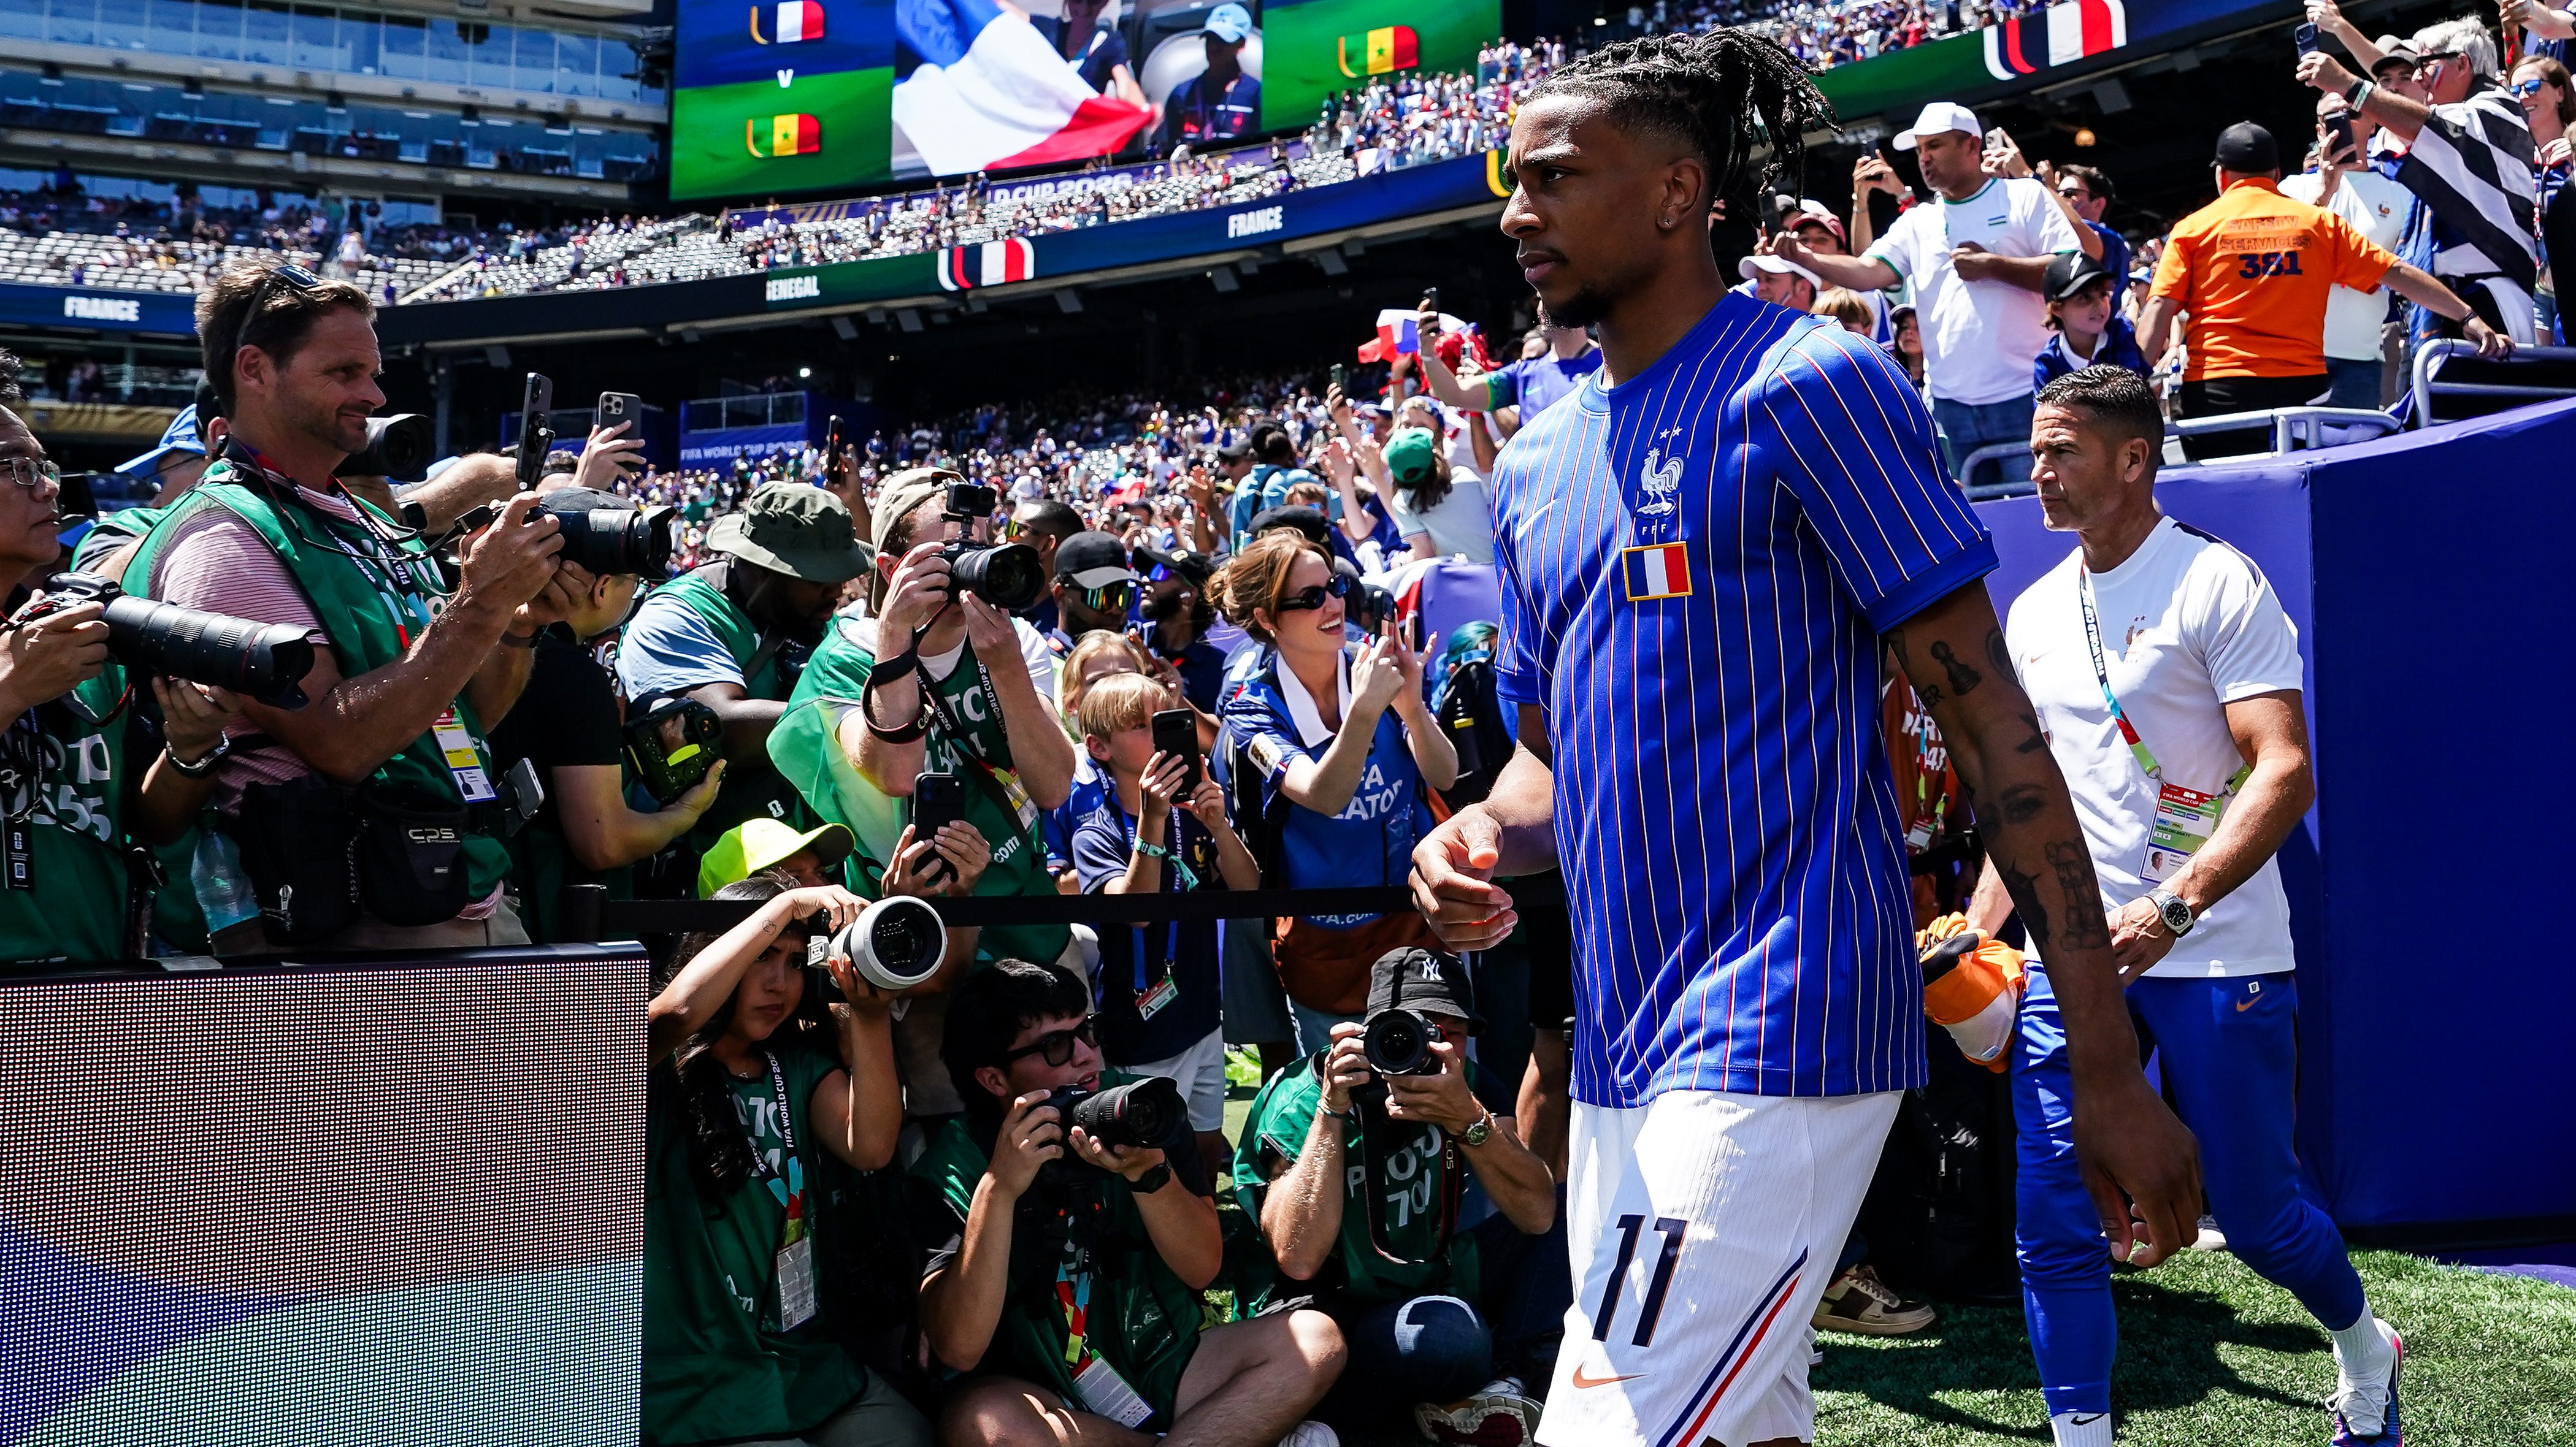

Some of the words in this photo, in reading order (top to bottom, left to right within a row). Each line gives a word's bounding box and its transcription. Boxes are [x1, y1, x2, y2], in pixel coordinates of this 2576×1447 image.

[776, 69, 794, 88] V
[1228, 205, 1283, 239] FRANCE
[2226, 216, 2299, 231] SAFETY
[2220, 234, 2312, 250] SERVICES
[2239, 251, 2302, 279] 381
[64, 296, 140, 321] FRANCE
[981, 674, 993, 692] CUP
[774, 1074, 785, 1093] CUP
[778, 1094, 791, 1128] WORLD
[785, 1128, 794, 1148] FIFA
[1446, 1140, 1454, 1170] EOS
[1592, 1214, 1690, 1348] 11
